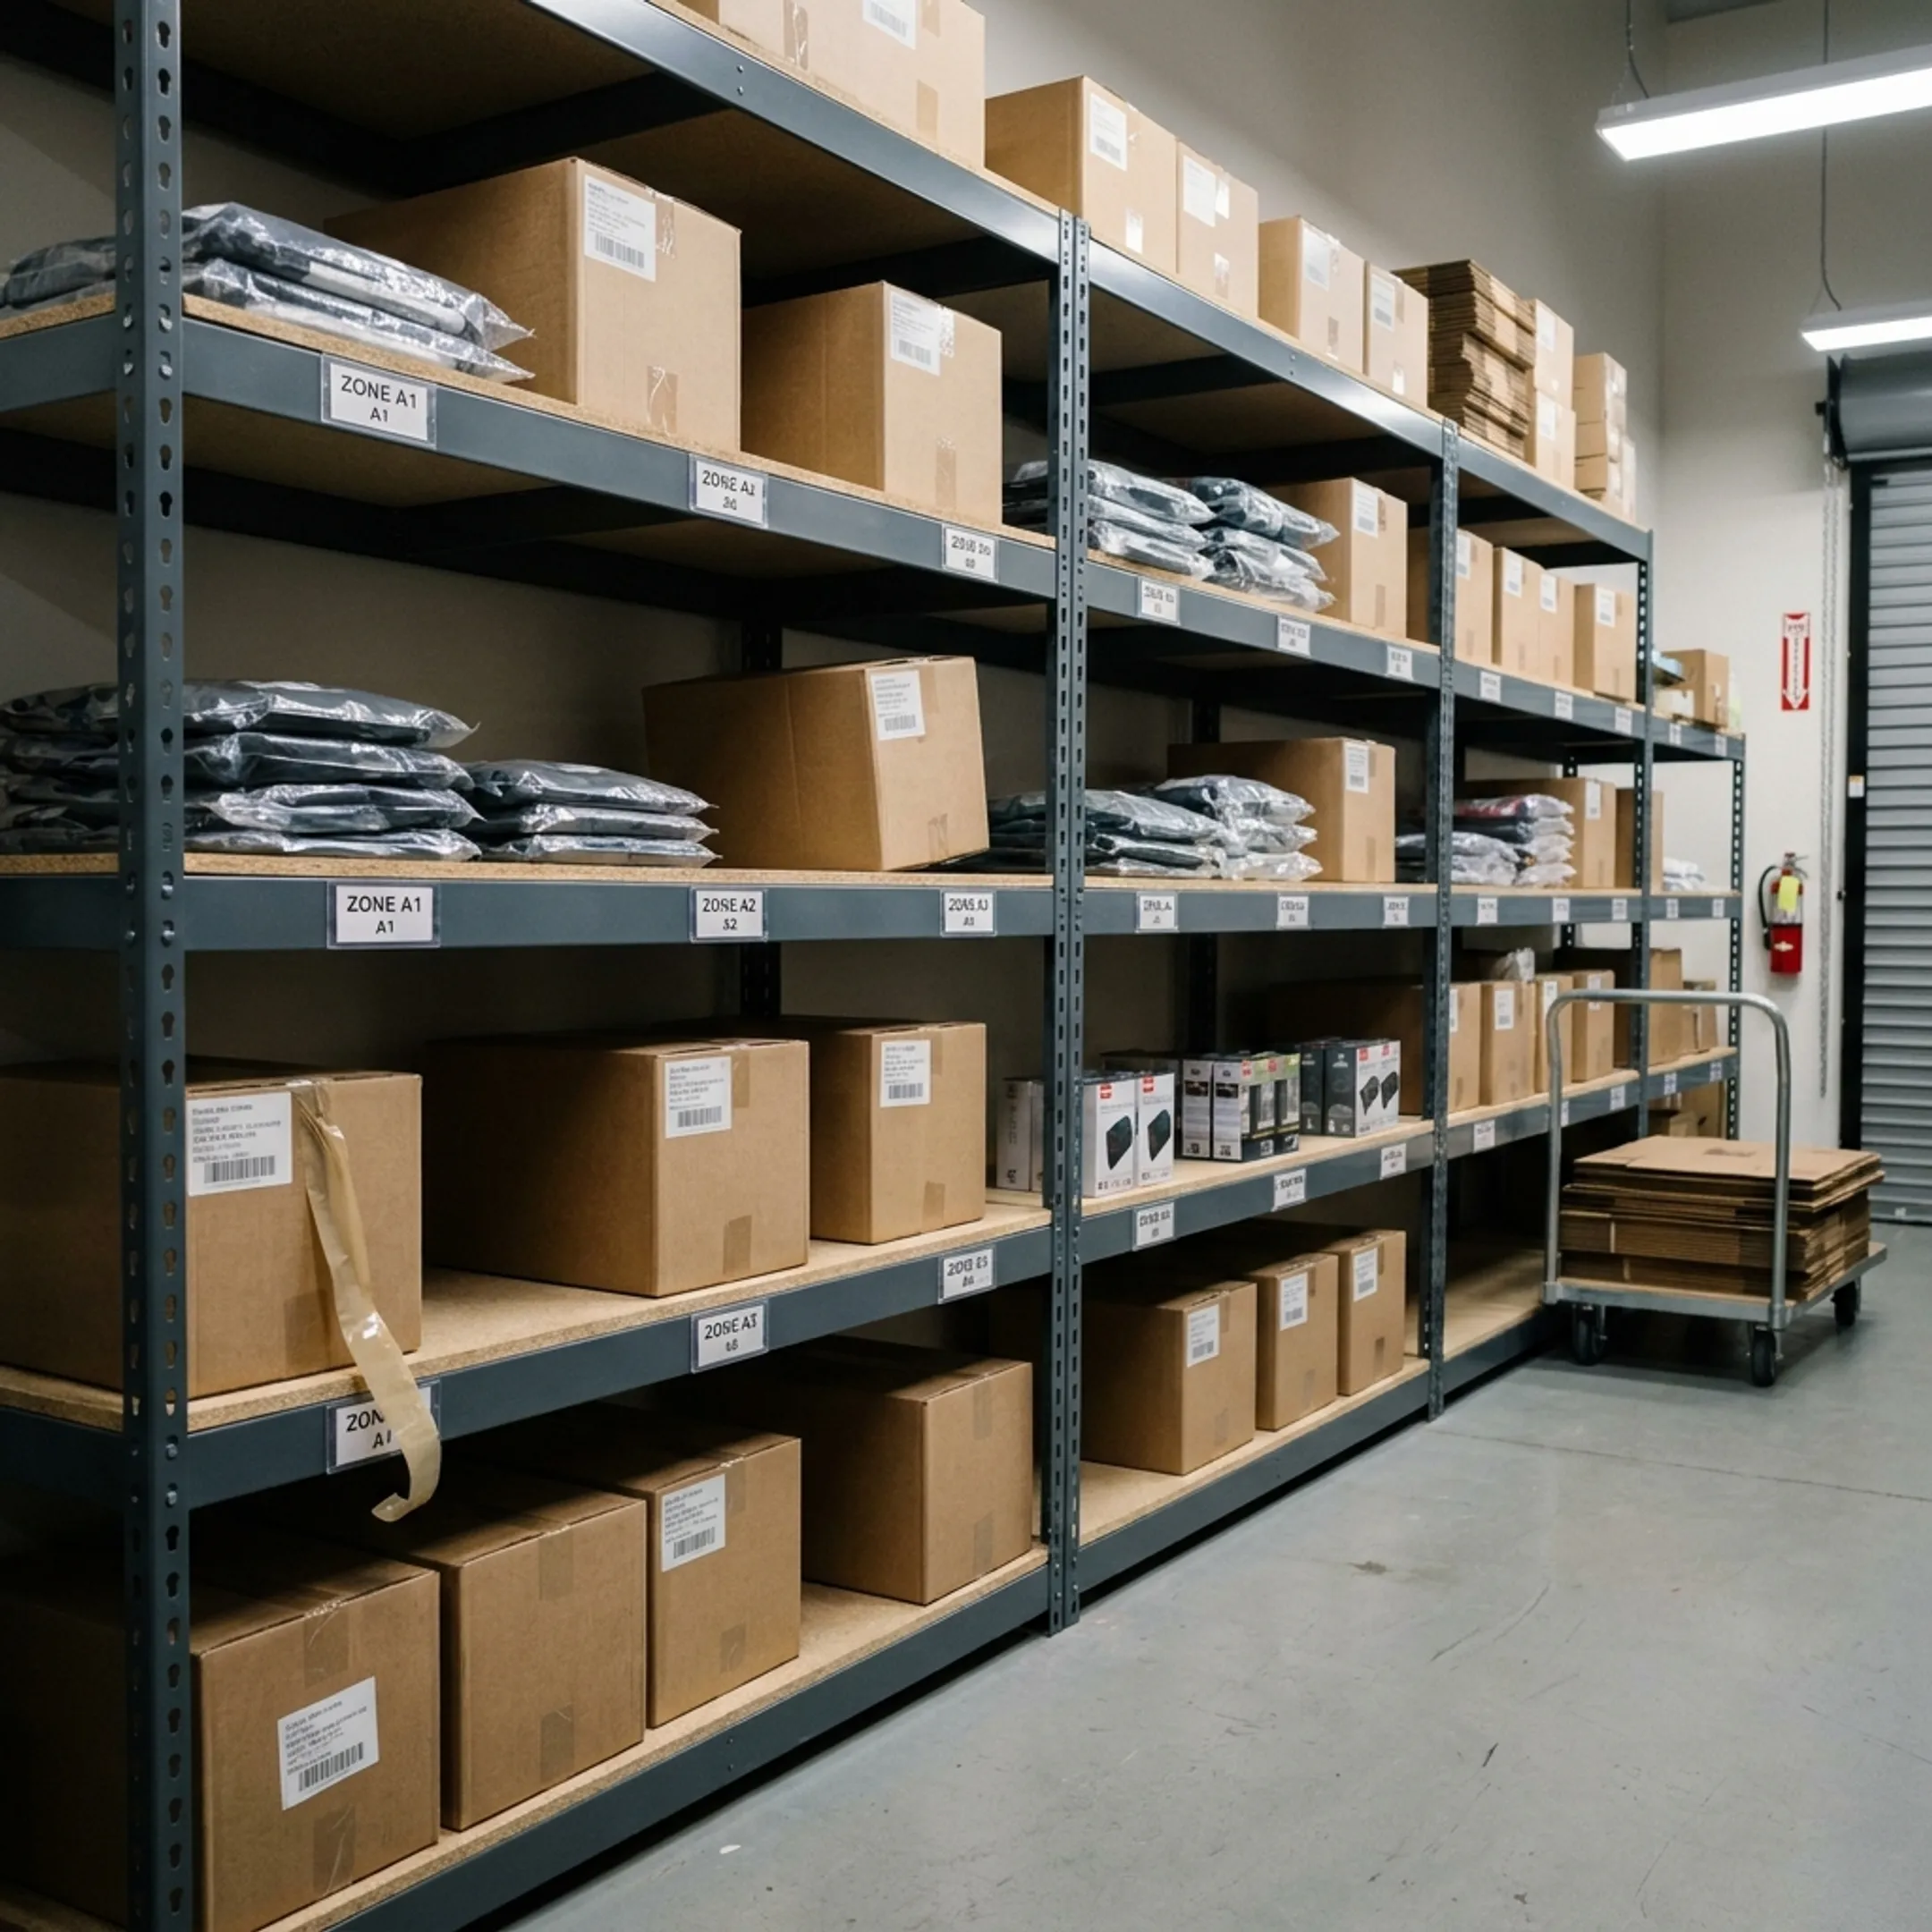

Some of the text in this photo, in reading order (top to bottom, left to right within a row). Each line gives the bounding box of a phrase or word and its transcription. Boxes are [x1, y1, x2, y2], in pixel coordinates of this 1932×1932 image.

[341, 374, 417, 409] ZONE A1
[369, 407, 389, 423] A1
[346, 895, 421, 912] ZONE A1
[375, 919, 394, 935] A1
[345, 1409, 386, 1433] ZON
